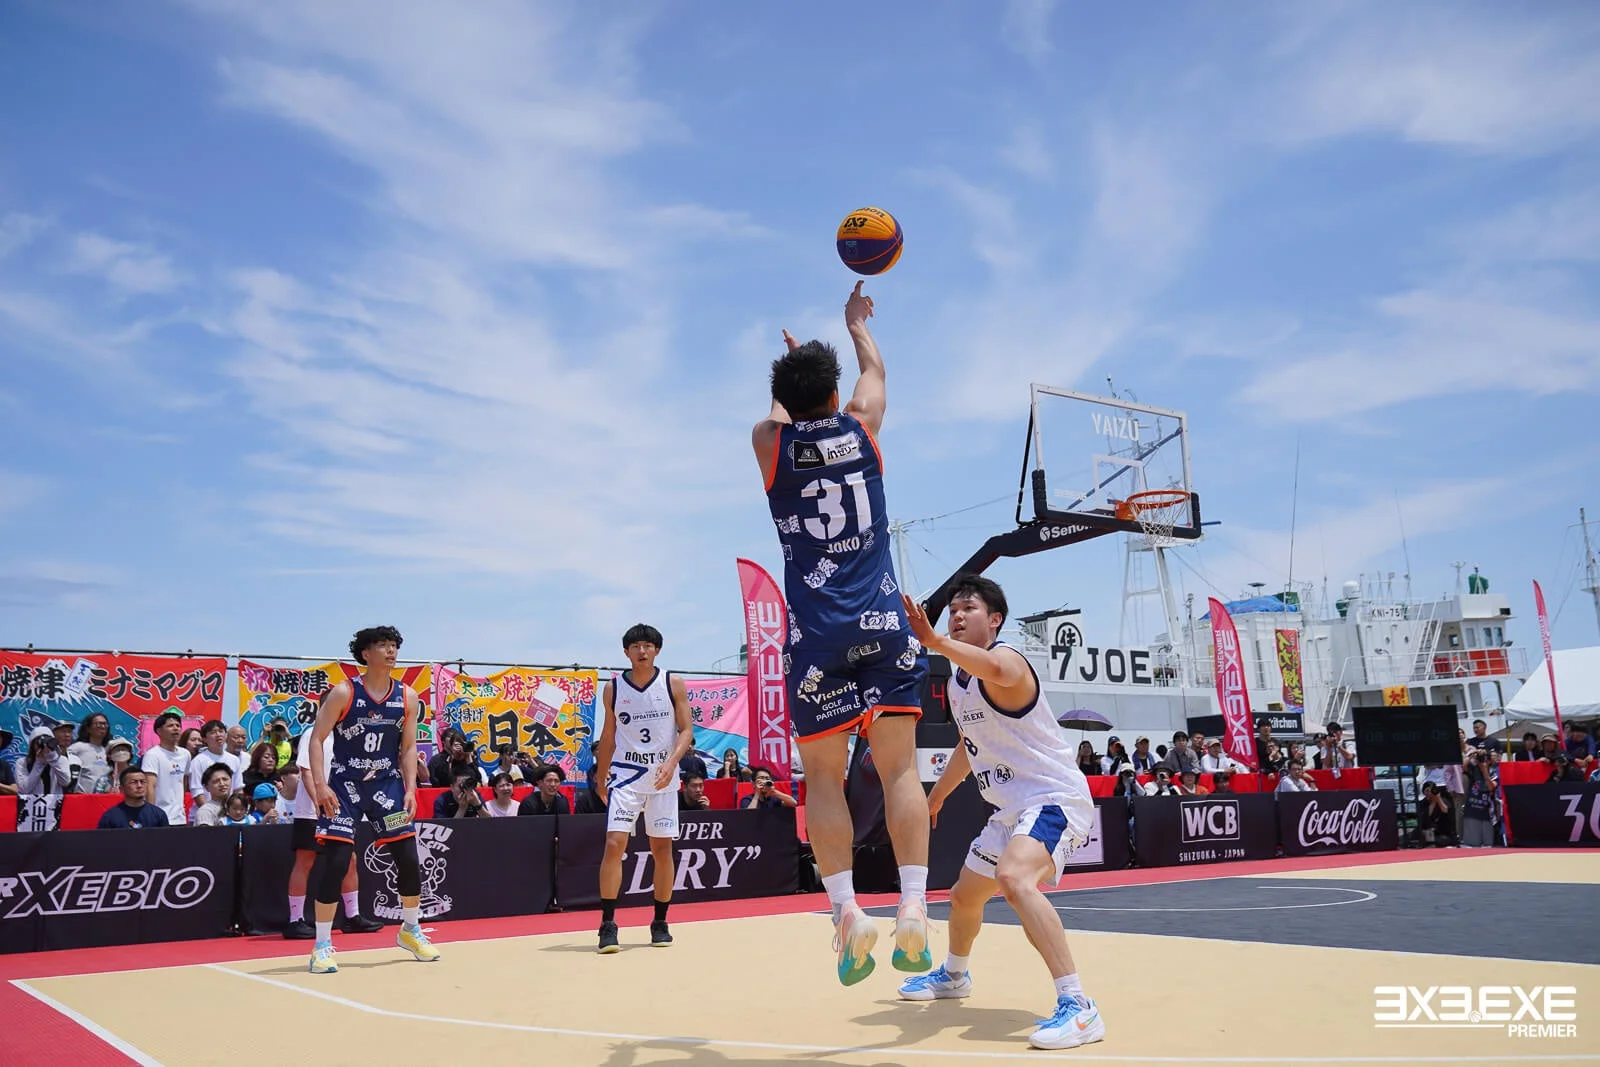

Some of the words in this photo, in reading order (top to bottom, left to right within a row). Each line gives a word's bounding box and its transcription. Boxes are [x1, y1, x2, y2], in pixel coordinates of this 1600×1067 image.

[1091, 412, 1140, 442] YAIZU
[801, 471, 873, 540] 31
[1051, 525, 1093, 539] Seno
[826, 536, 860, 554] JOKO
[0, 666, 66, 698] 焼津
[88, 667, 223, 701] ミナミマグロ
[272, 669, 329, 694] 焼津
[461, 681, 496, 698] 大漁
[444, 707, 485, 723] 水揚げ
[816, 704, 853, 722] PARTNER
[822, 699, 843, 711] GOLF
[488, 709, 591, 755] 日本一
[639, 728, 651, 743] 3
[363, 732, 385, 753] 81
[672, 822, 724, 841] UPER
[1183, 806, 1238, 837] WCB
[1298, 798, 1381, 848] Coca-Cola
[1178, 850, 1216, 862] SHIZUOKA
[1224, 849, 1245, 858] JAPAN
[4, 866, 214, 918] XEBIO
